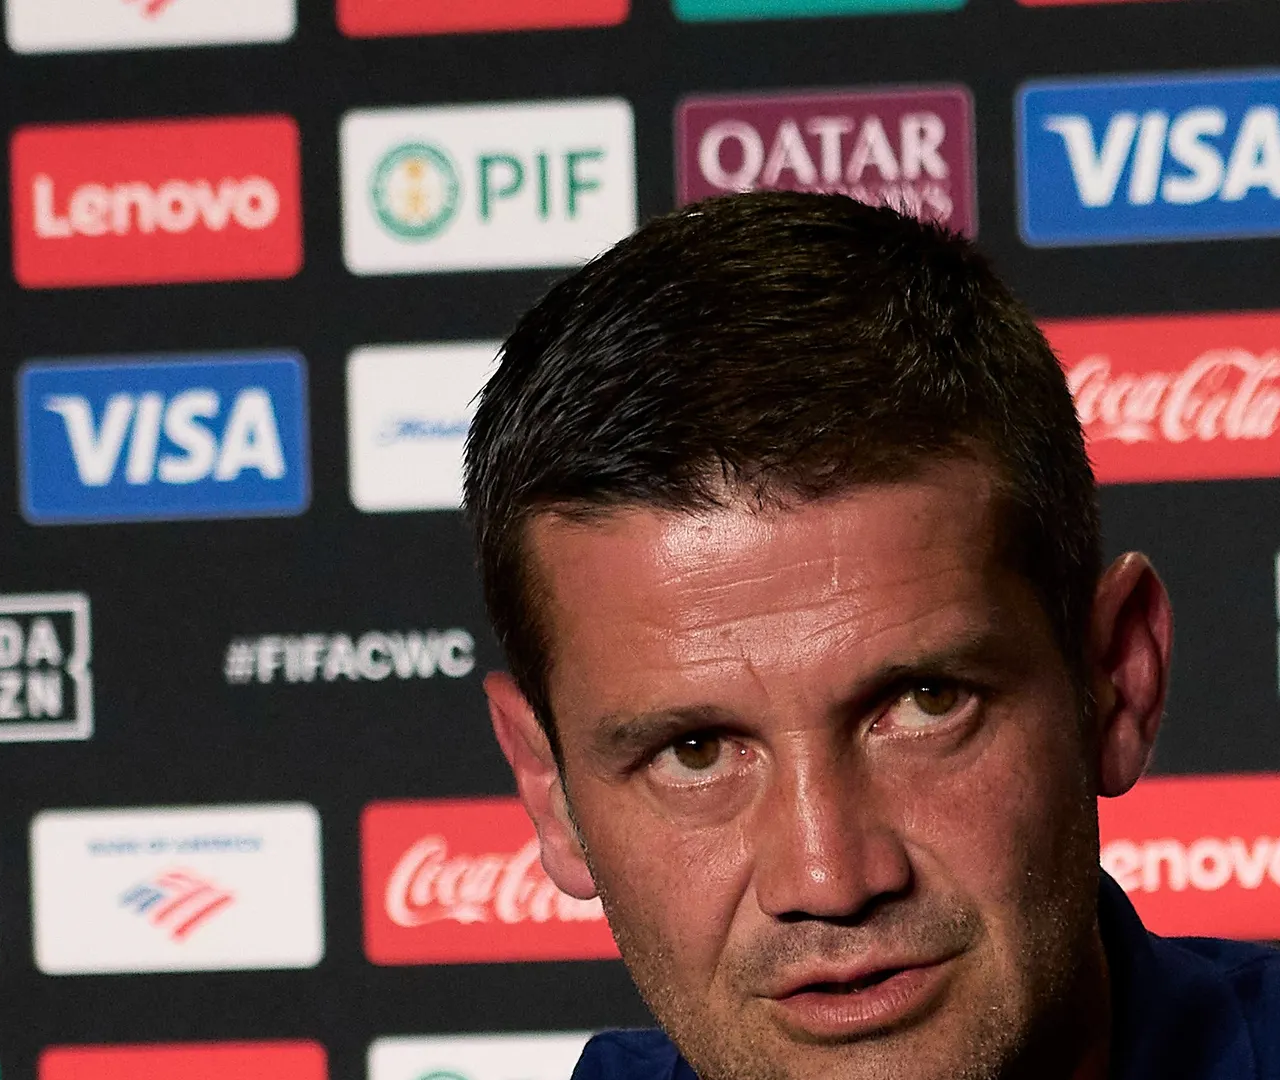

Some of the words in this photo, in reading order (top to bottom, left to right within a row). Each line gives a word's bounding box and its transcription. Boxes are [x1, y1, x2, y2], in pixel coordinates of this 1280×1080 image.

[477, 149, 603, 221] PIF
[699, 114, 947, 194] QATAR
[33, 176, 279, 238] Lenovo
[47, 388, 285, 486] VISA
[225, 630, 474, 683] #FIFACWC
